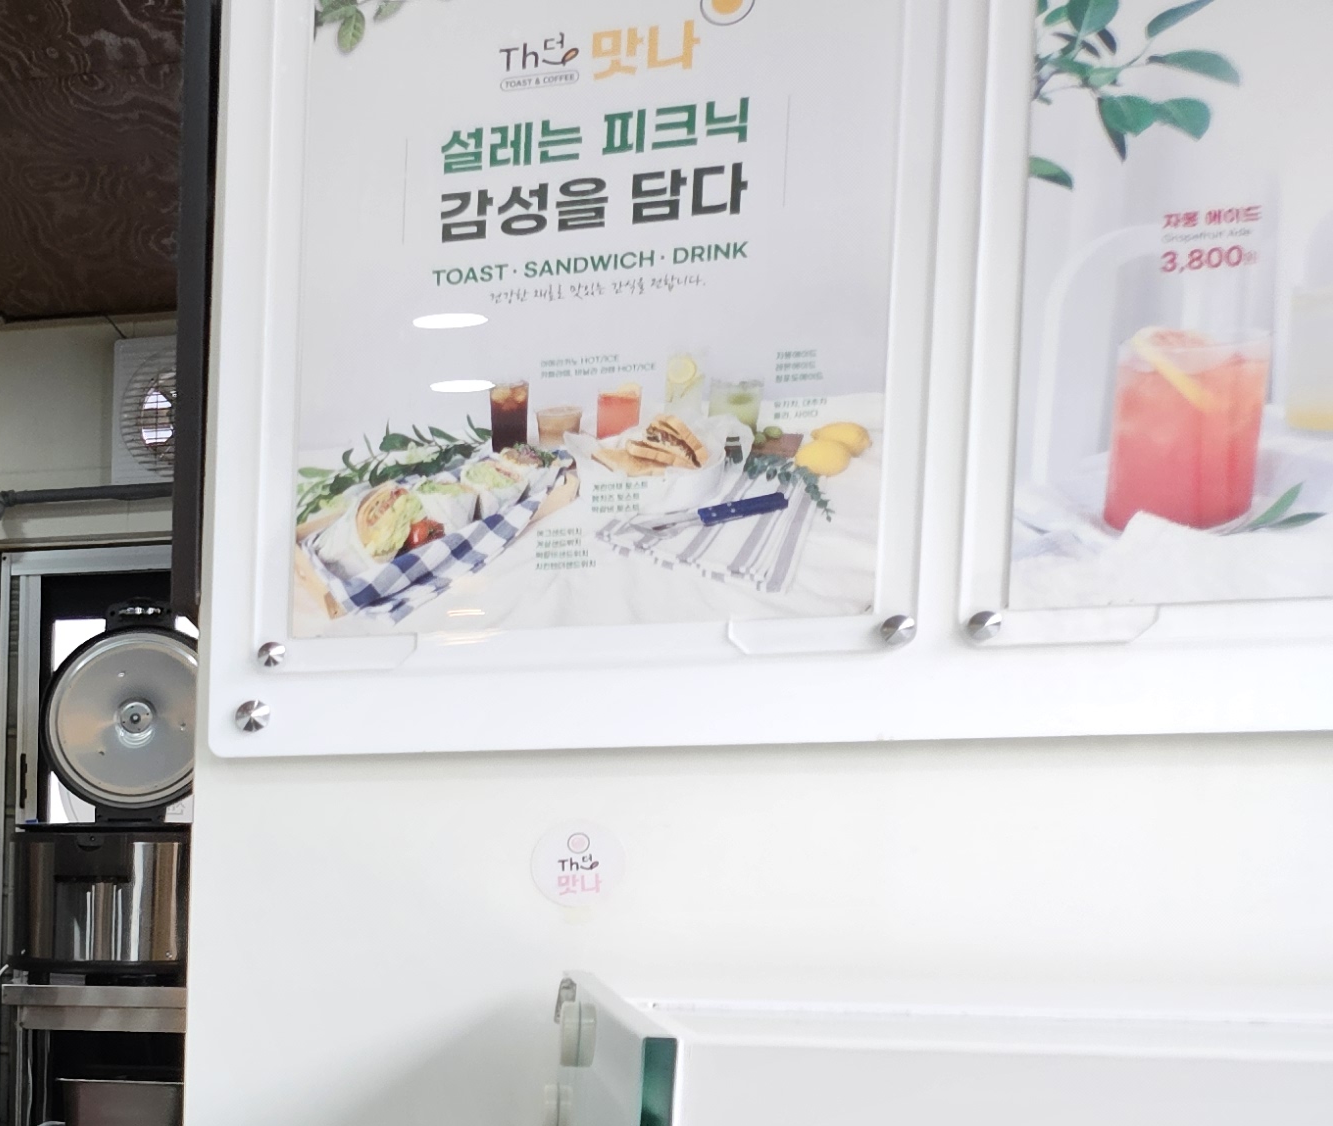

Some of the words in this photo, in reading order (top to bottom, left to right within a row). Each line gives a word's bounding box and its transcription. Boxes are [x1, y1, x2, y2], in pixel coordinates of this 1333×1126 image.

[592, 20, 700, 81] 맛나
[505, 78, 533, 88] TOAST
[543, 73, 574, 84] COFFEE
[442, 119, 582, 174] 설레는
[602, 97, 749, 155] 피크닉
[441, 177, 608, 243] 감성을
[632, 162, 748, 225] 담다
[1205, 205, 1262, 225] 에이드
[433, 264, 509, 286] TOAST
[524, 250, 655, 278] SANDWICH
[673, 241, 748, 265] DRINK
[489, 289, 529, 304] 건강한
[570, 281, 605, 298] 맛있는
[612, 277, 645, 295] 간식을
[558, 873, 602, 896] 맛나
